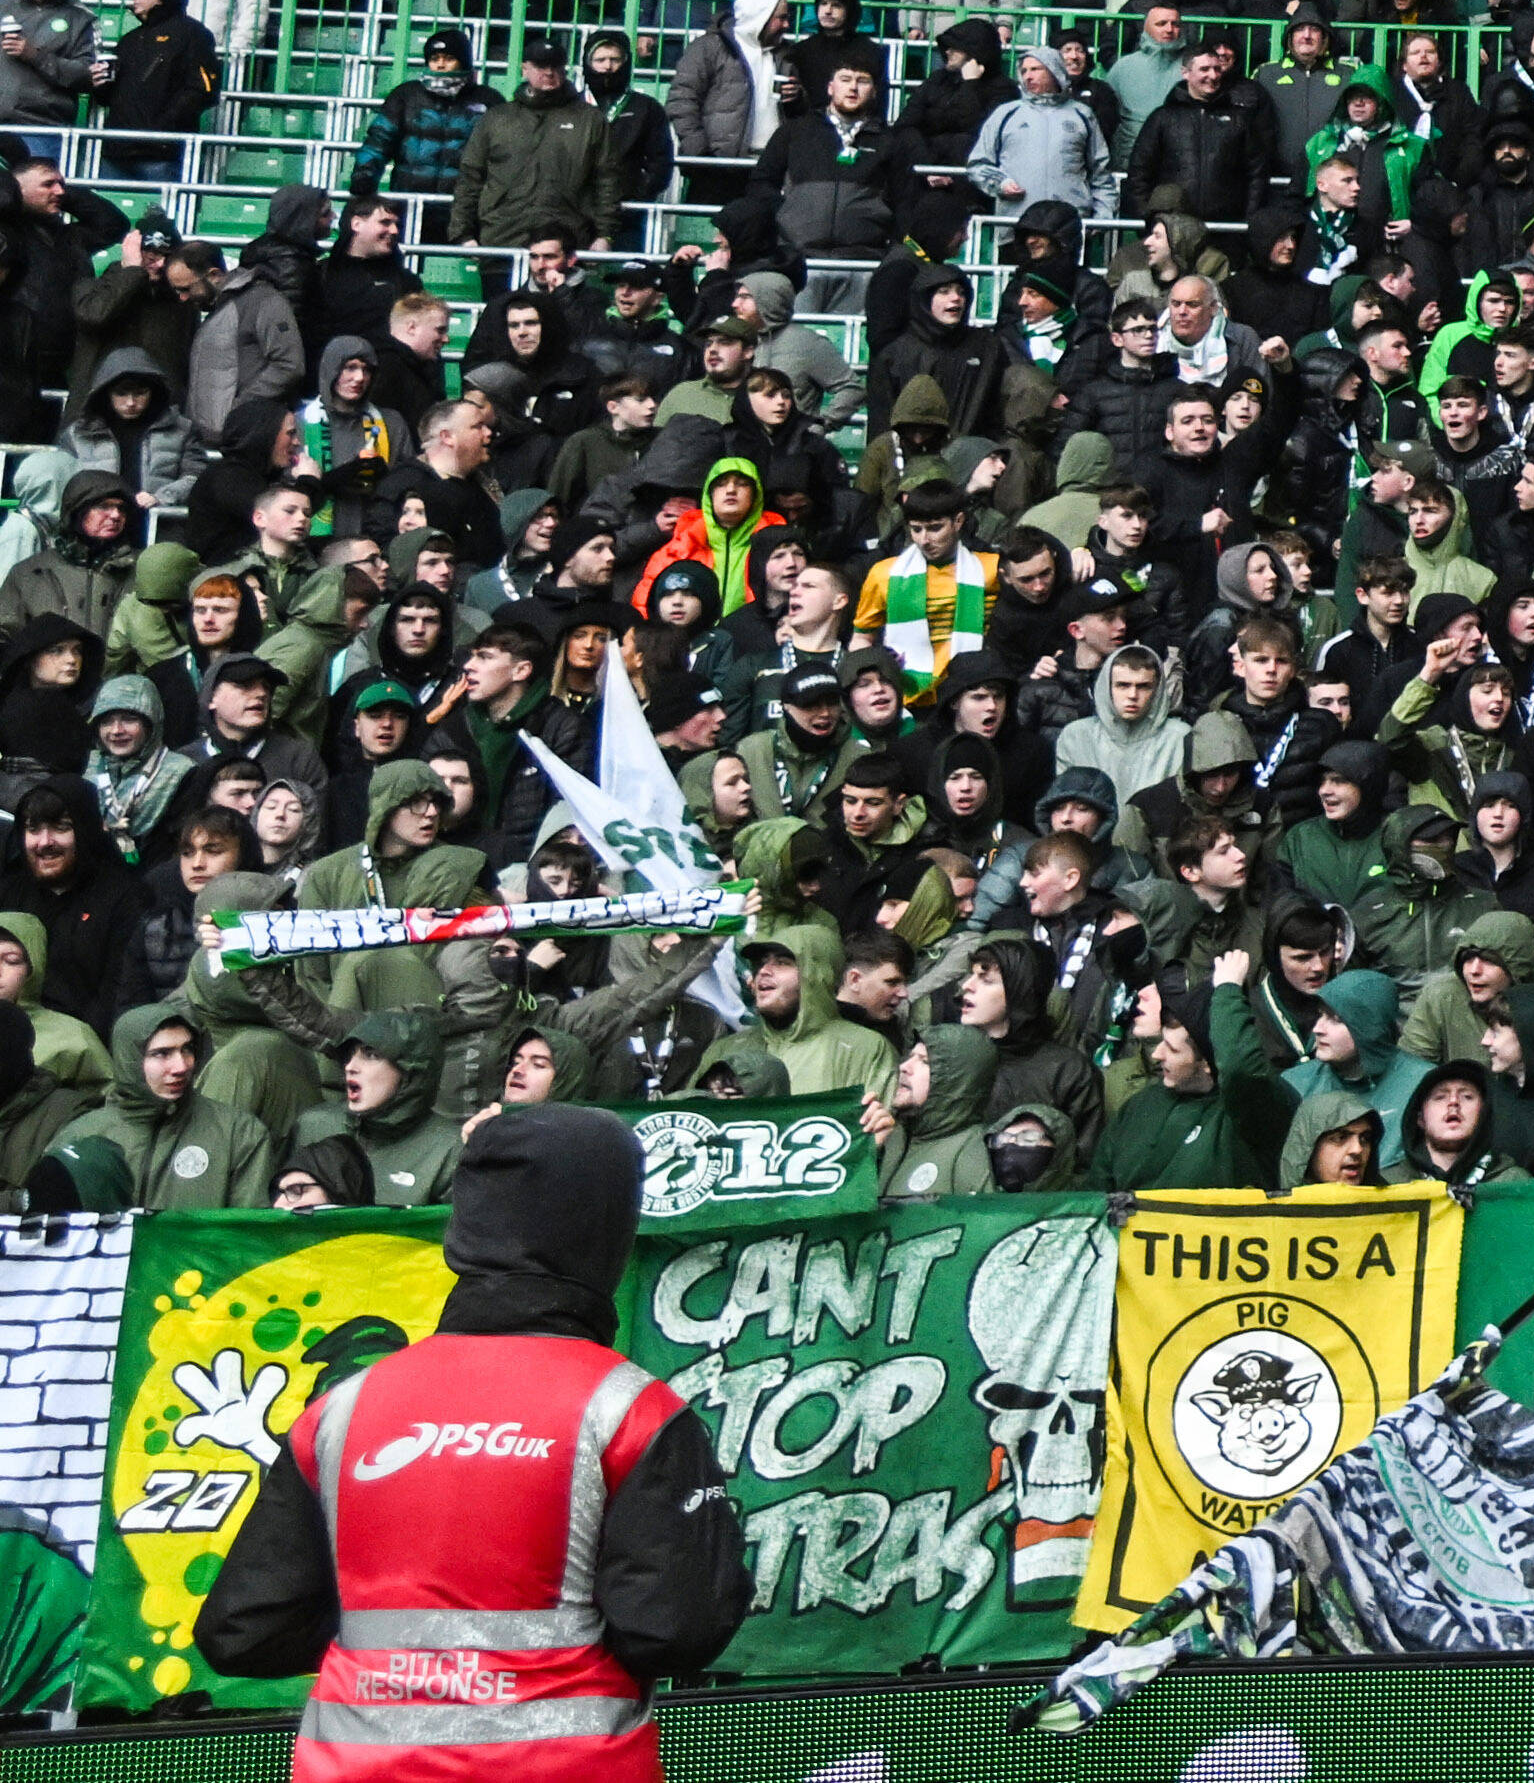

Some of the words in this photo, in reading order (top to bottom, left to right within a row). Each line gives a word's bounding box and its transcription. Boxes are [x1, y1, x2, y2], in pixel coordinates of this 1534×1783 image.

[1133, 1229, 1269, 1282] THIS
[1288, 1235, 1338, 1281] IS
[1357, 1232, 1396, 1279] A
[654, 1224, 963, 1349] CANT
[1237, 1302, 1289, 1327] PIG
[389, 1652, 479, 1676] PITCH
[355, 1671, 518, 1701] RESPONSE
